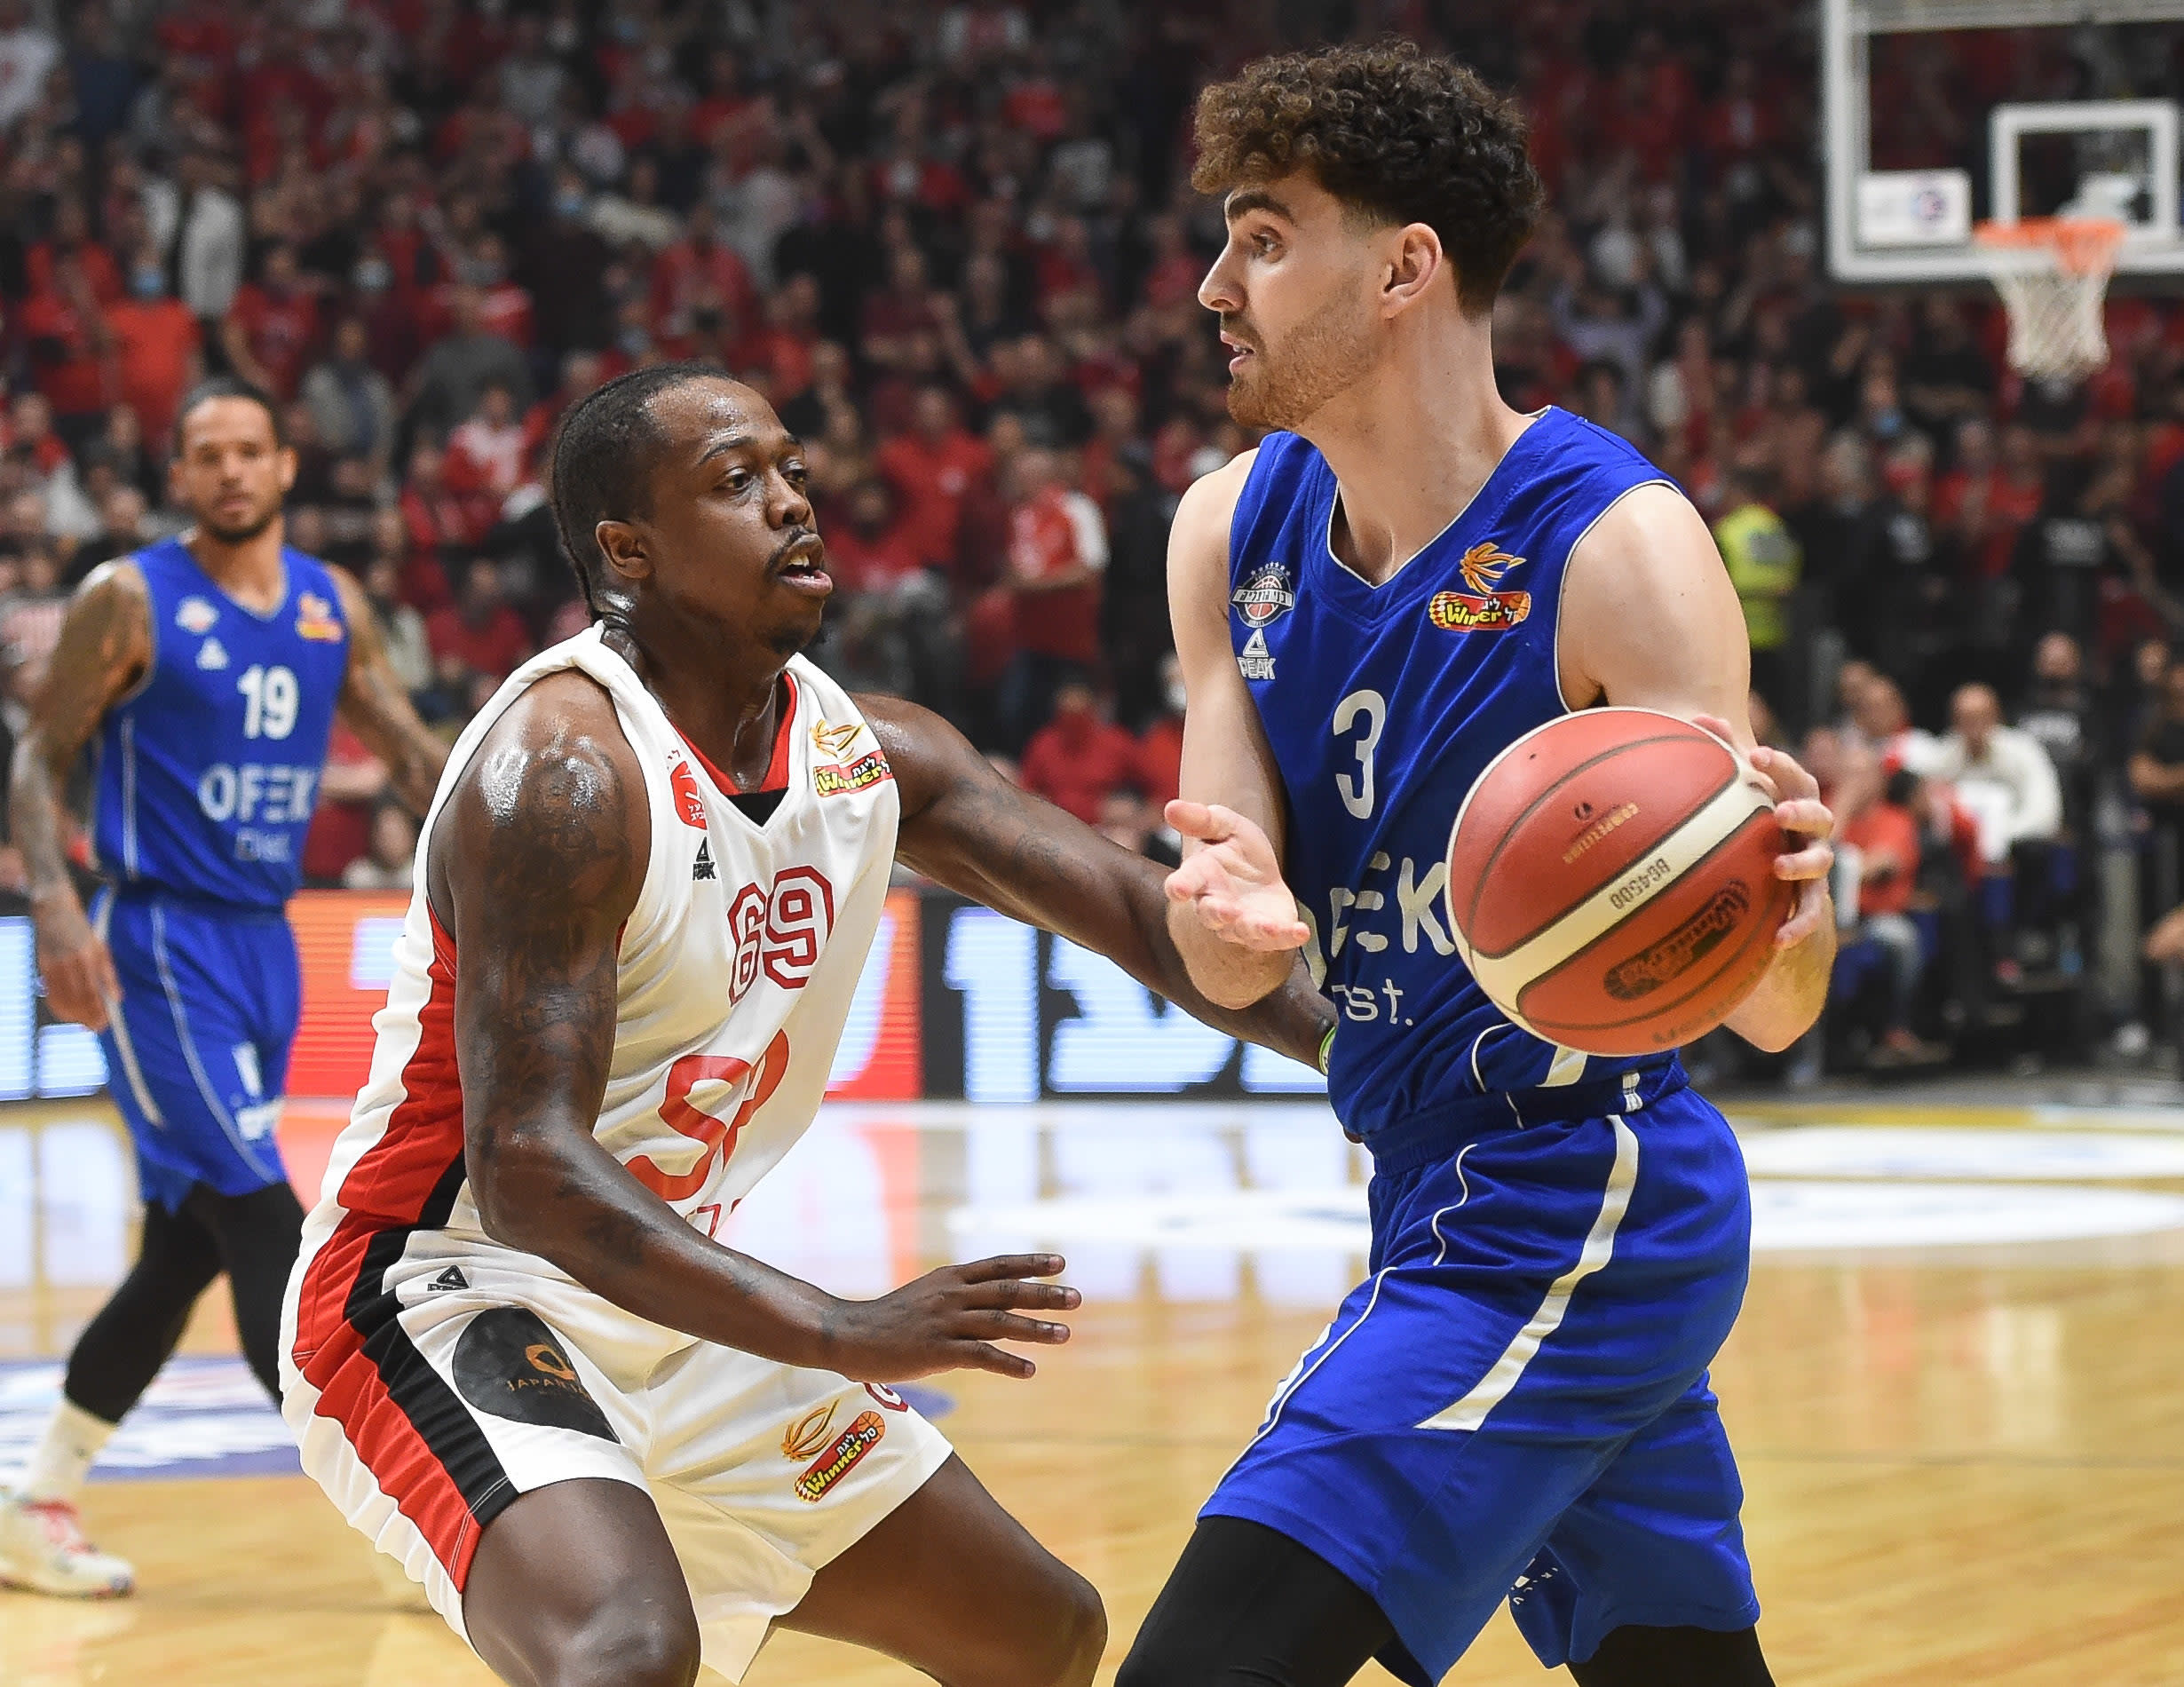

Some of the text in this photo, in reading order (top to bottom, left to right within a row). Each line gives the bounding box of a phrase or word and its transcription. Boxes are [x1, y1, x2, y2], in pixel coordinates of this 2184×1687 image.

[1237, 657, 1276, 680] PEAK
[236, 664, 300, 741] 19
[1333, 689, 1386, 820] 3
[1610, 858, 1671, 909] BG4500
[727, 866, 834, 1007] 69
[805, 1440, 863, 1493] Winner
